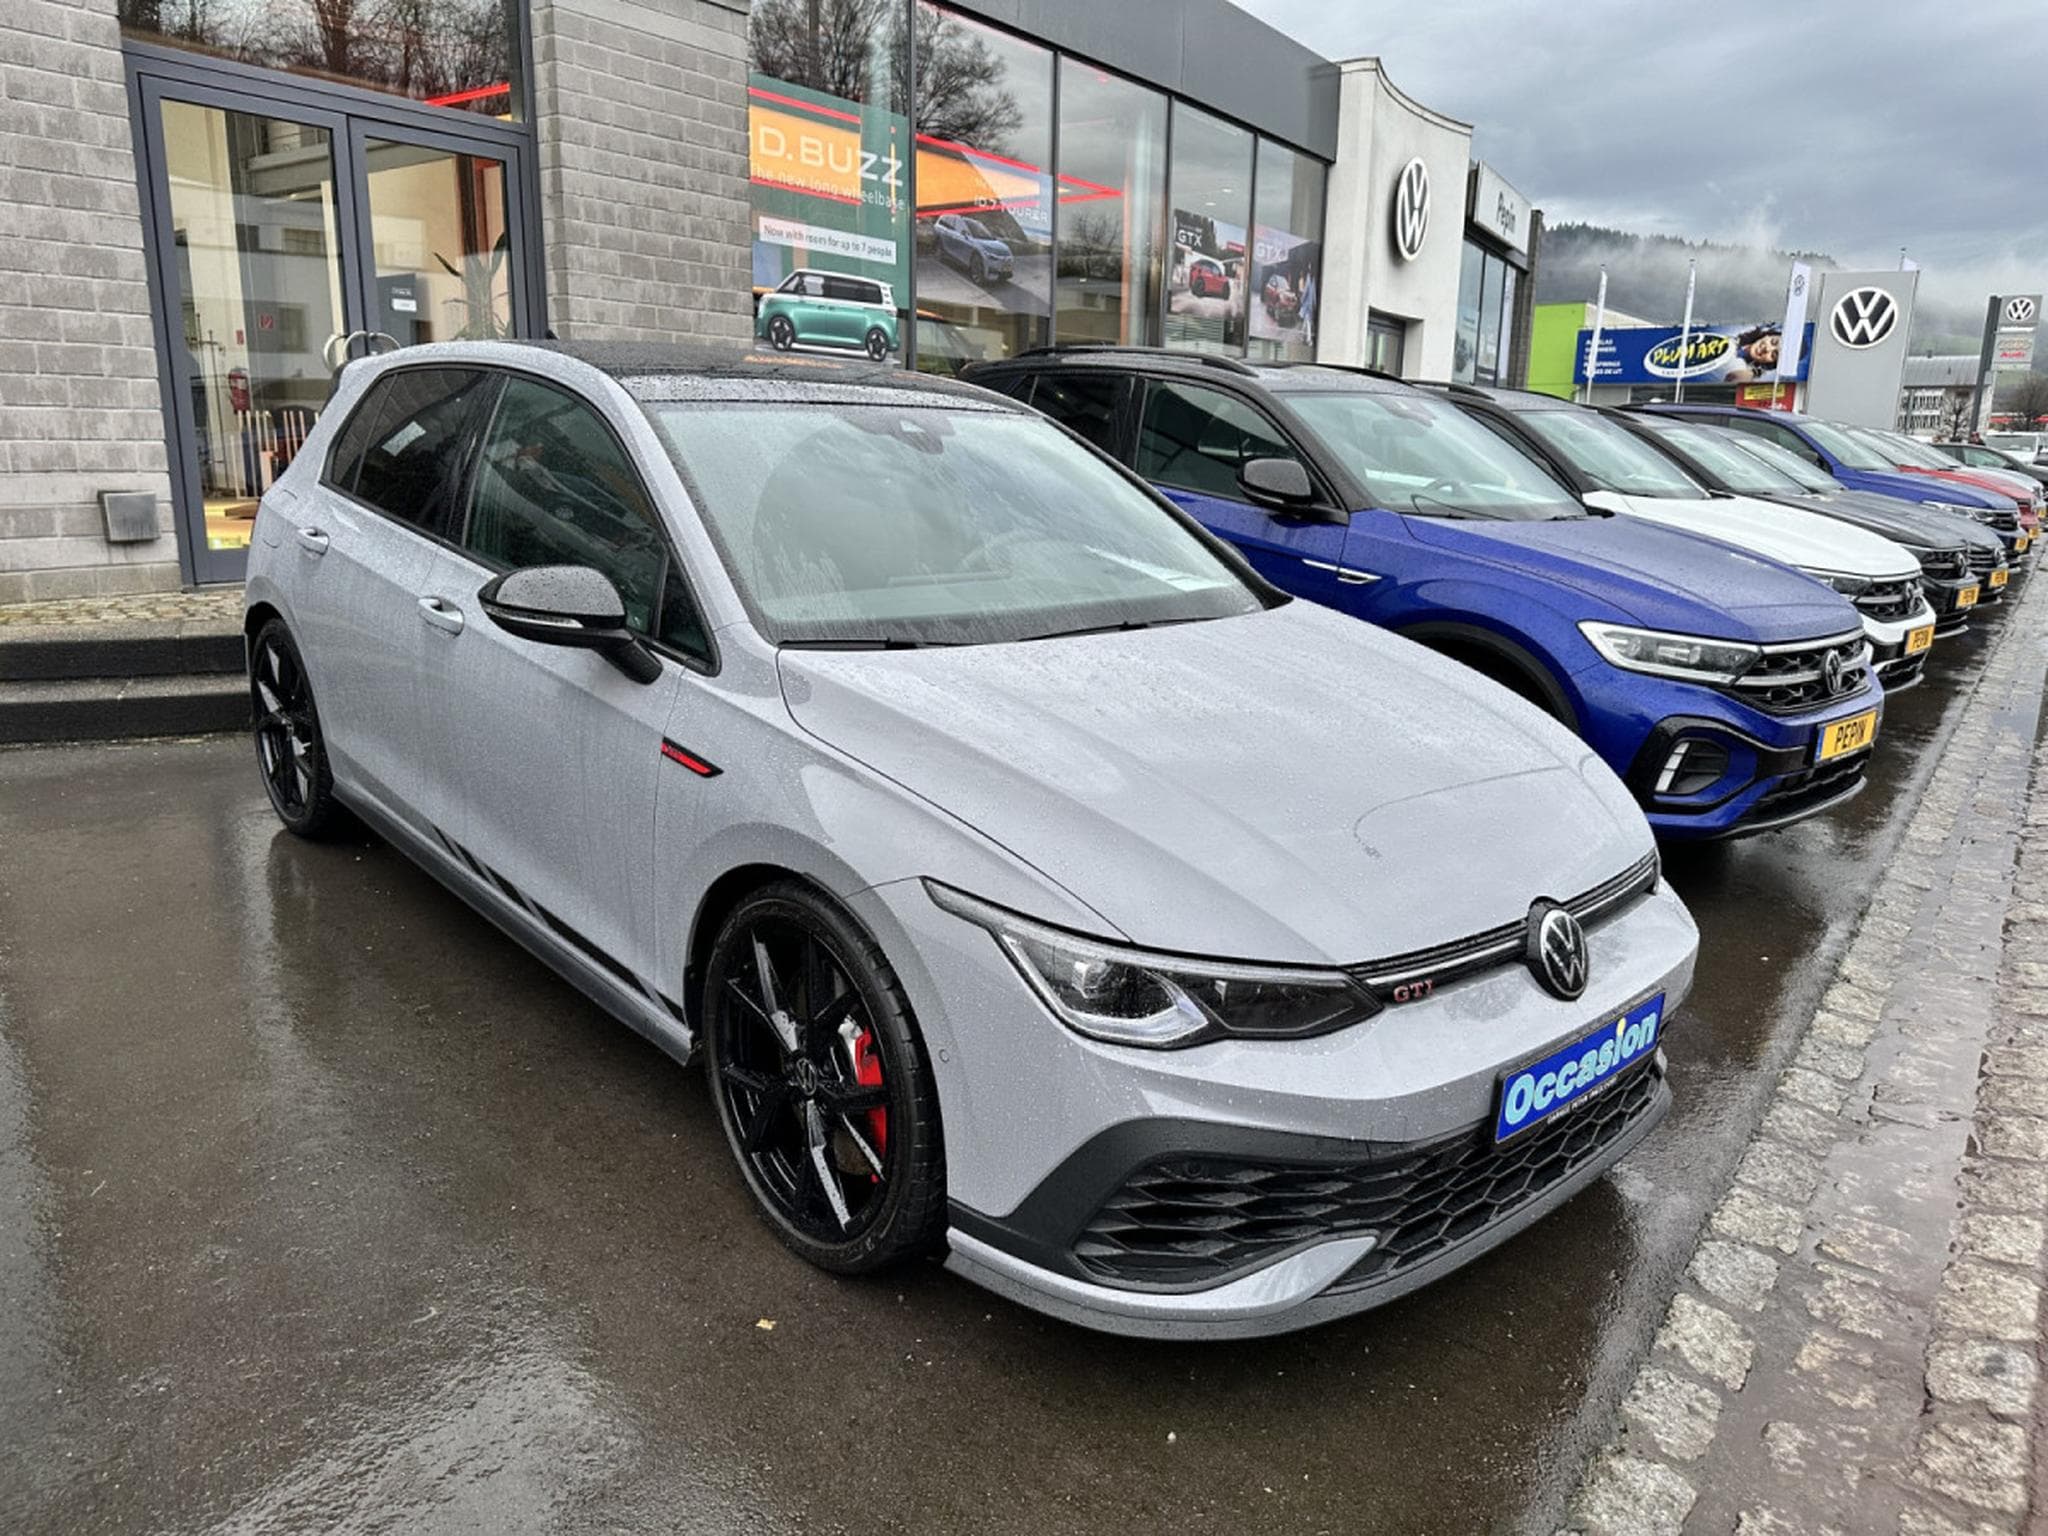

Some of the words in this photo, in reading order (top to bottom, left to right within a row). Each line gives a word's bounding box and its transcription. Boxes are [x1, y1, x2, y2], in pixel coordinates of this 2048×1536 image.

[764, 224, 783, 237] Now
[786, 229, 804, 240] with
[805, 235, 826, 245] room
[828, 235, 838, 247] for
[1178, 229, 1202, 248] GTX
[1394, 979, 1433, 1003] GTI
[1504, 1012, 1658, 1126] Occasion
